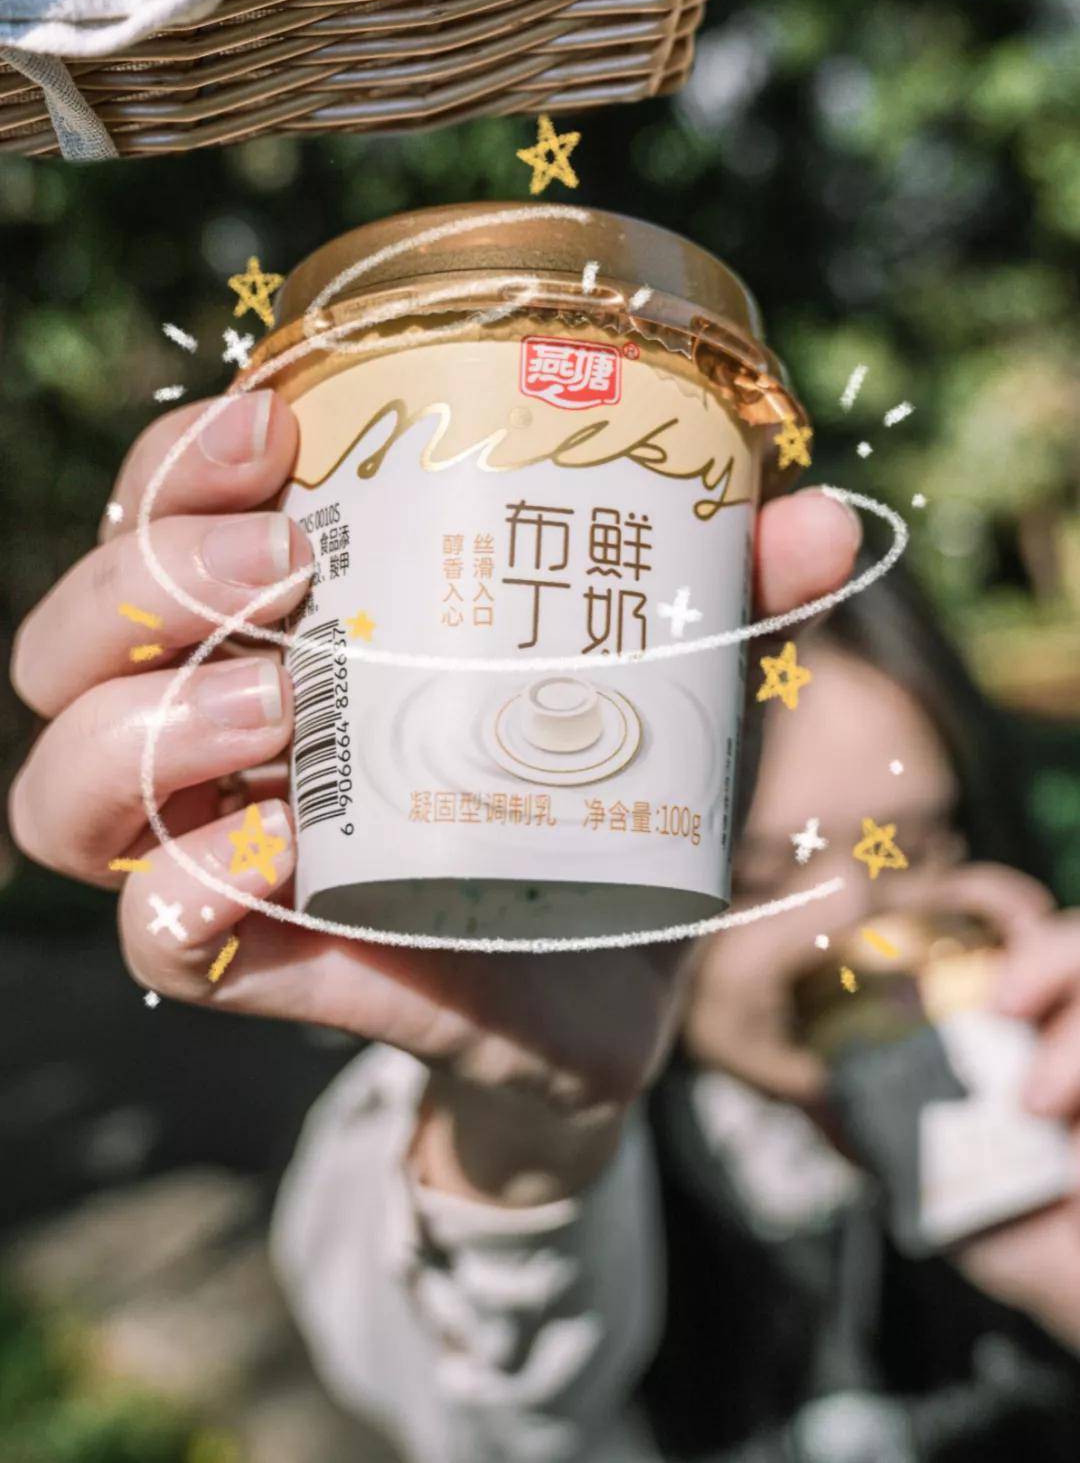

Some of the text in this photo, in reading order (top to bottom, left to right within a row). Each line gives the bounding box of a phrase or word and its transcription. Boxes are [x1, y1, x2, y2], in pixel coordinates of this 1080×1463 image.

[527, 343, 617, 392] 燕塘
[441, 533, 465, 628] 醇香入心
[472, 533, 495, 627] 丝滑入口
[407, 790, 557, 828] 凝固型调制乳
[581, 798, 702, 847] 净含量:100g
